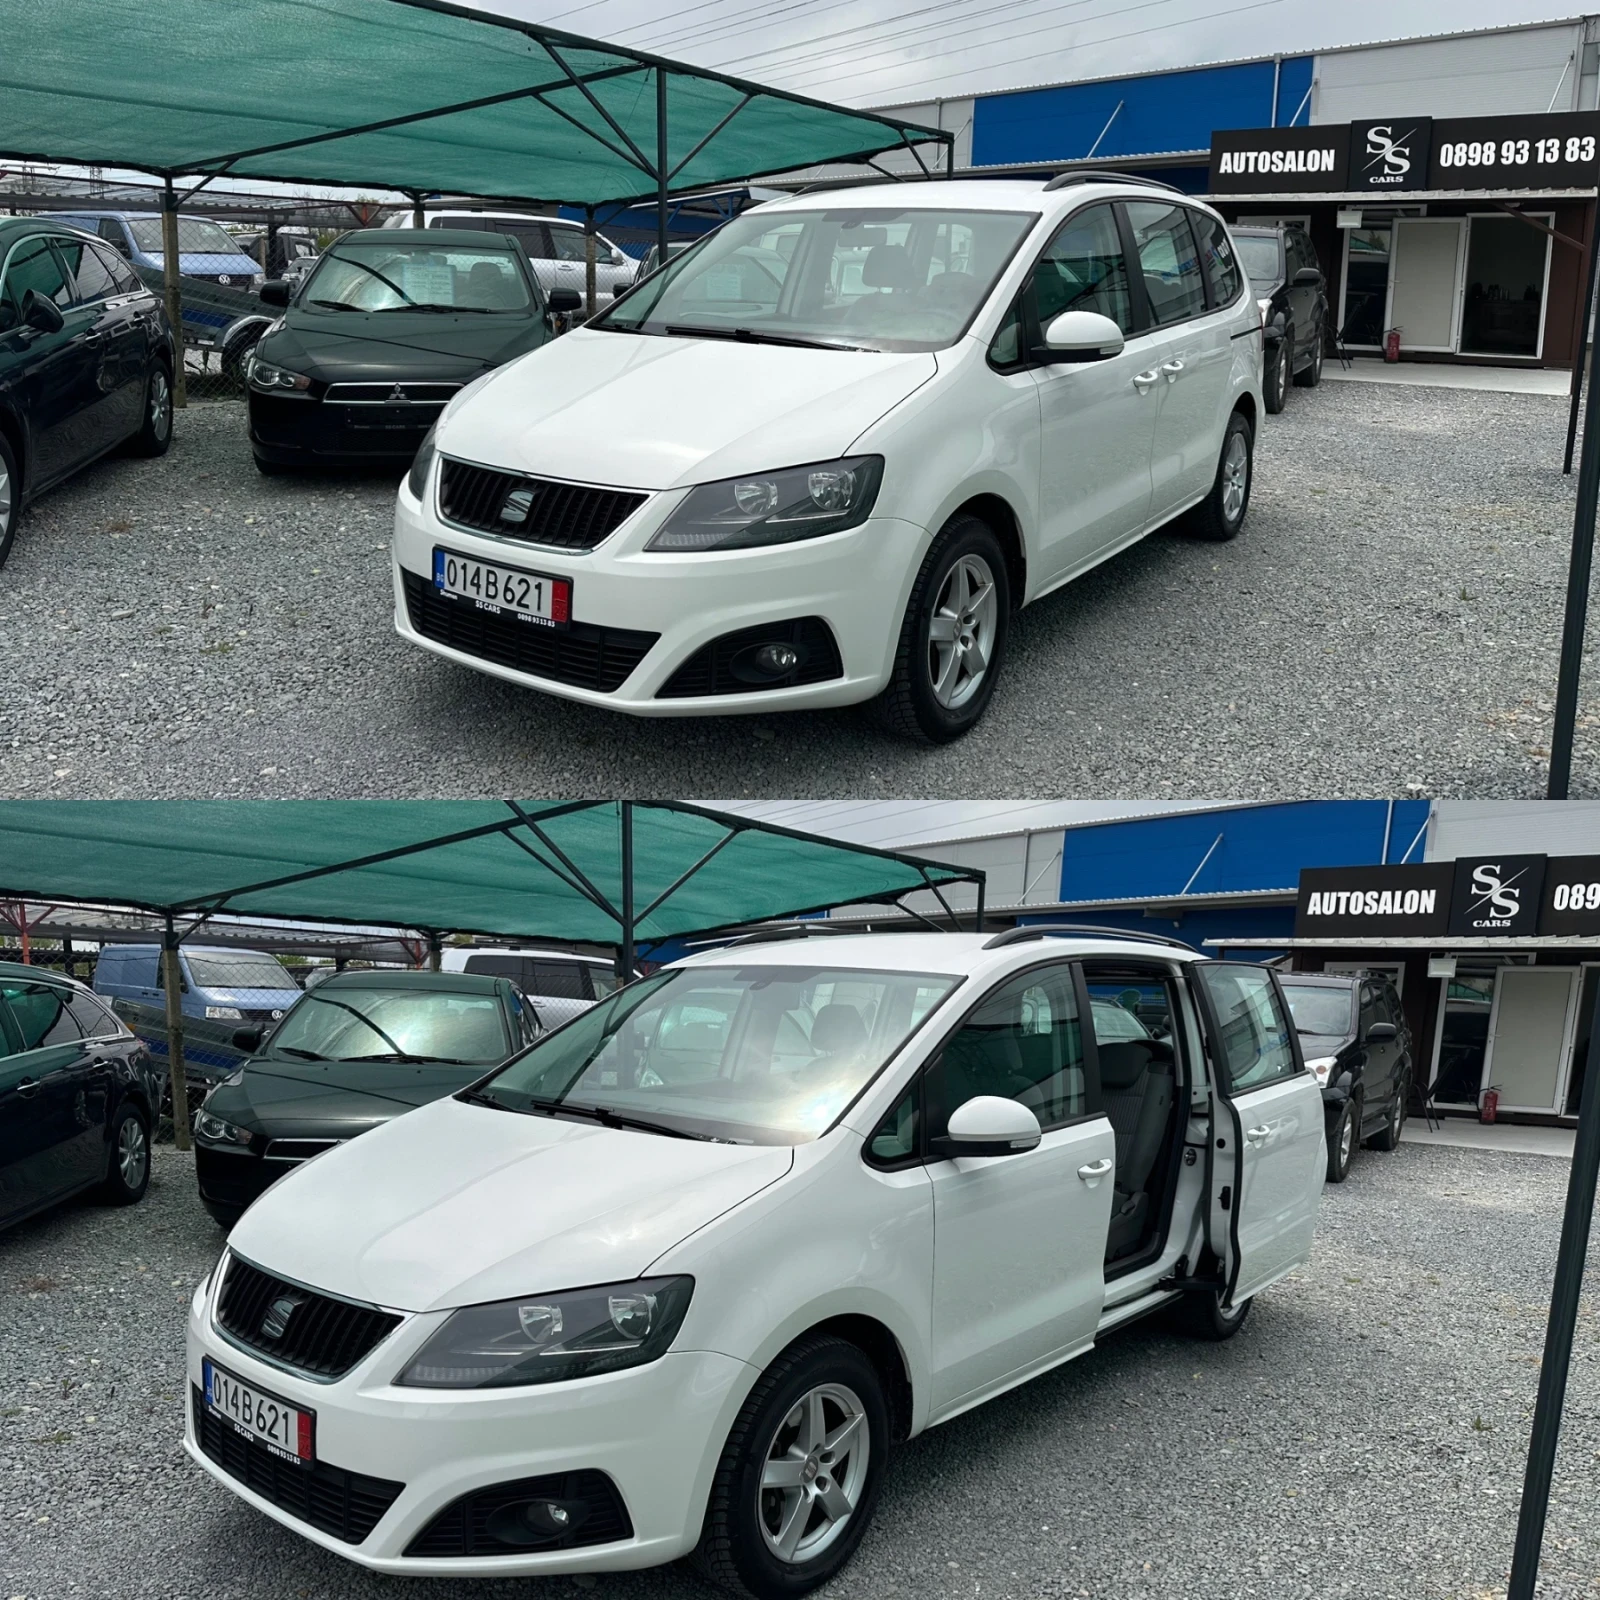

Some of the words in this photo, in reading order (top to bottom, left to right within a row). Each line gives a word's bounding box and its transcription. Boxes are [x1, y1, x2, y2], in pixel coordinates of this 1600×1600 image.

[1439, 141, 1496, 168] 0898
[1500, 139, 1530, 166] 93
[1535, 138, 1561, 164] 13
[1565, 136, 1596, 162] 83
[1219, 149, 1335, 174] AUTOSALON
[1369, 175, 1404, 184] CARS
[475, 600, 484, 609] SS
[484, 602, 501, 614] CARS
[517, 613, 532, 622] 0898
[532, 616, 540, 624] 93
[540, 618, 547, 626] 13
[1307, 889, 1436, 915] AUTOSALON
[1472, 919, 1511, 928] CARS
[240, 1426, 254, 1442] CARS
